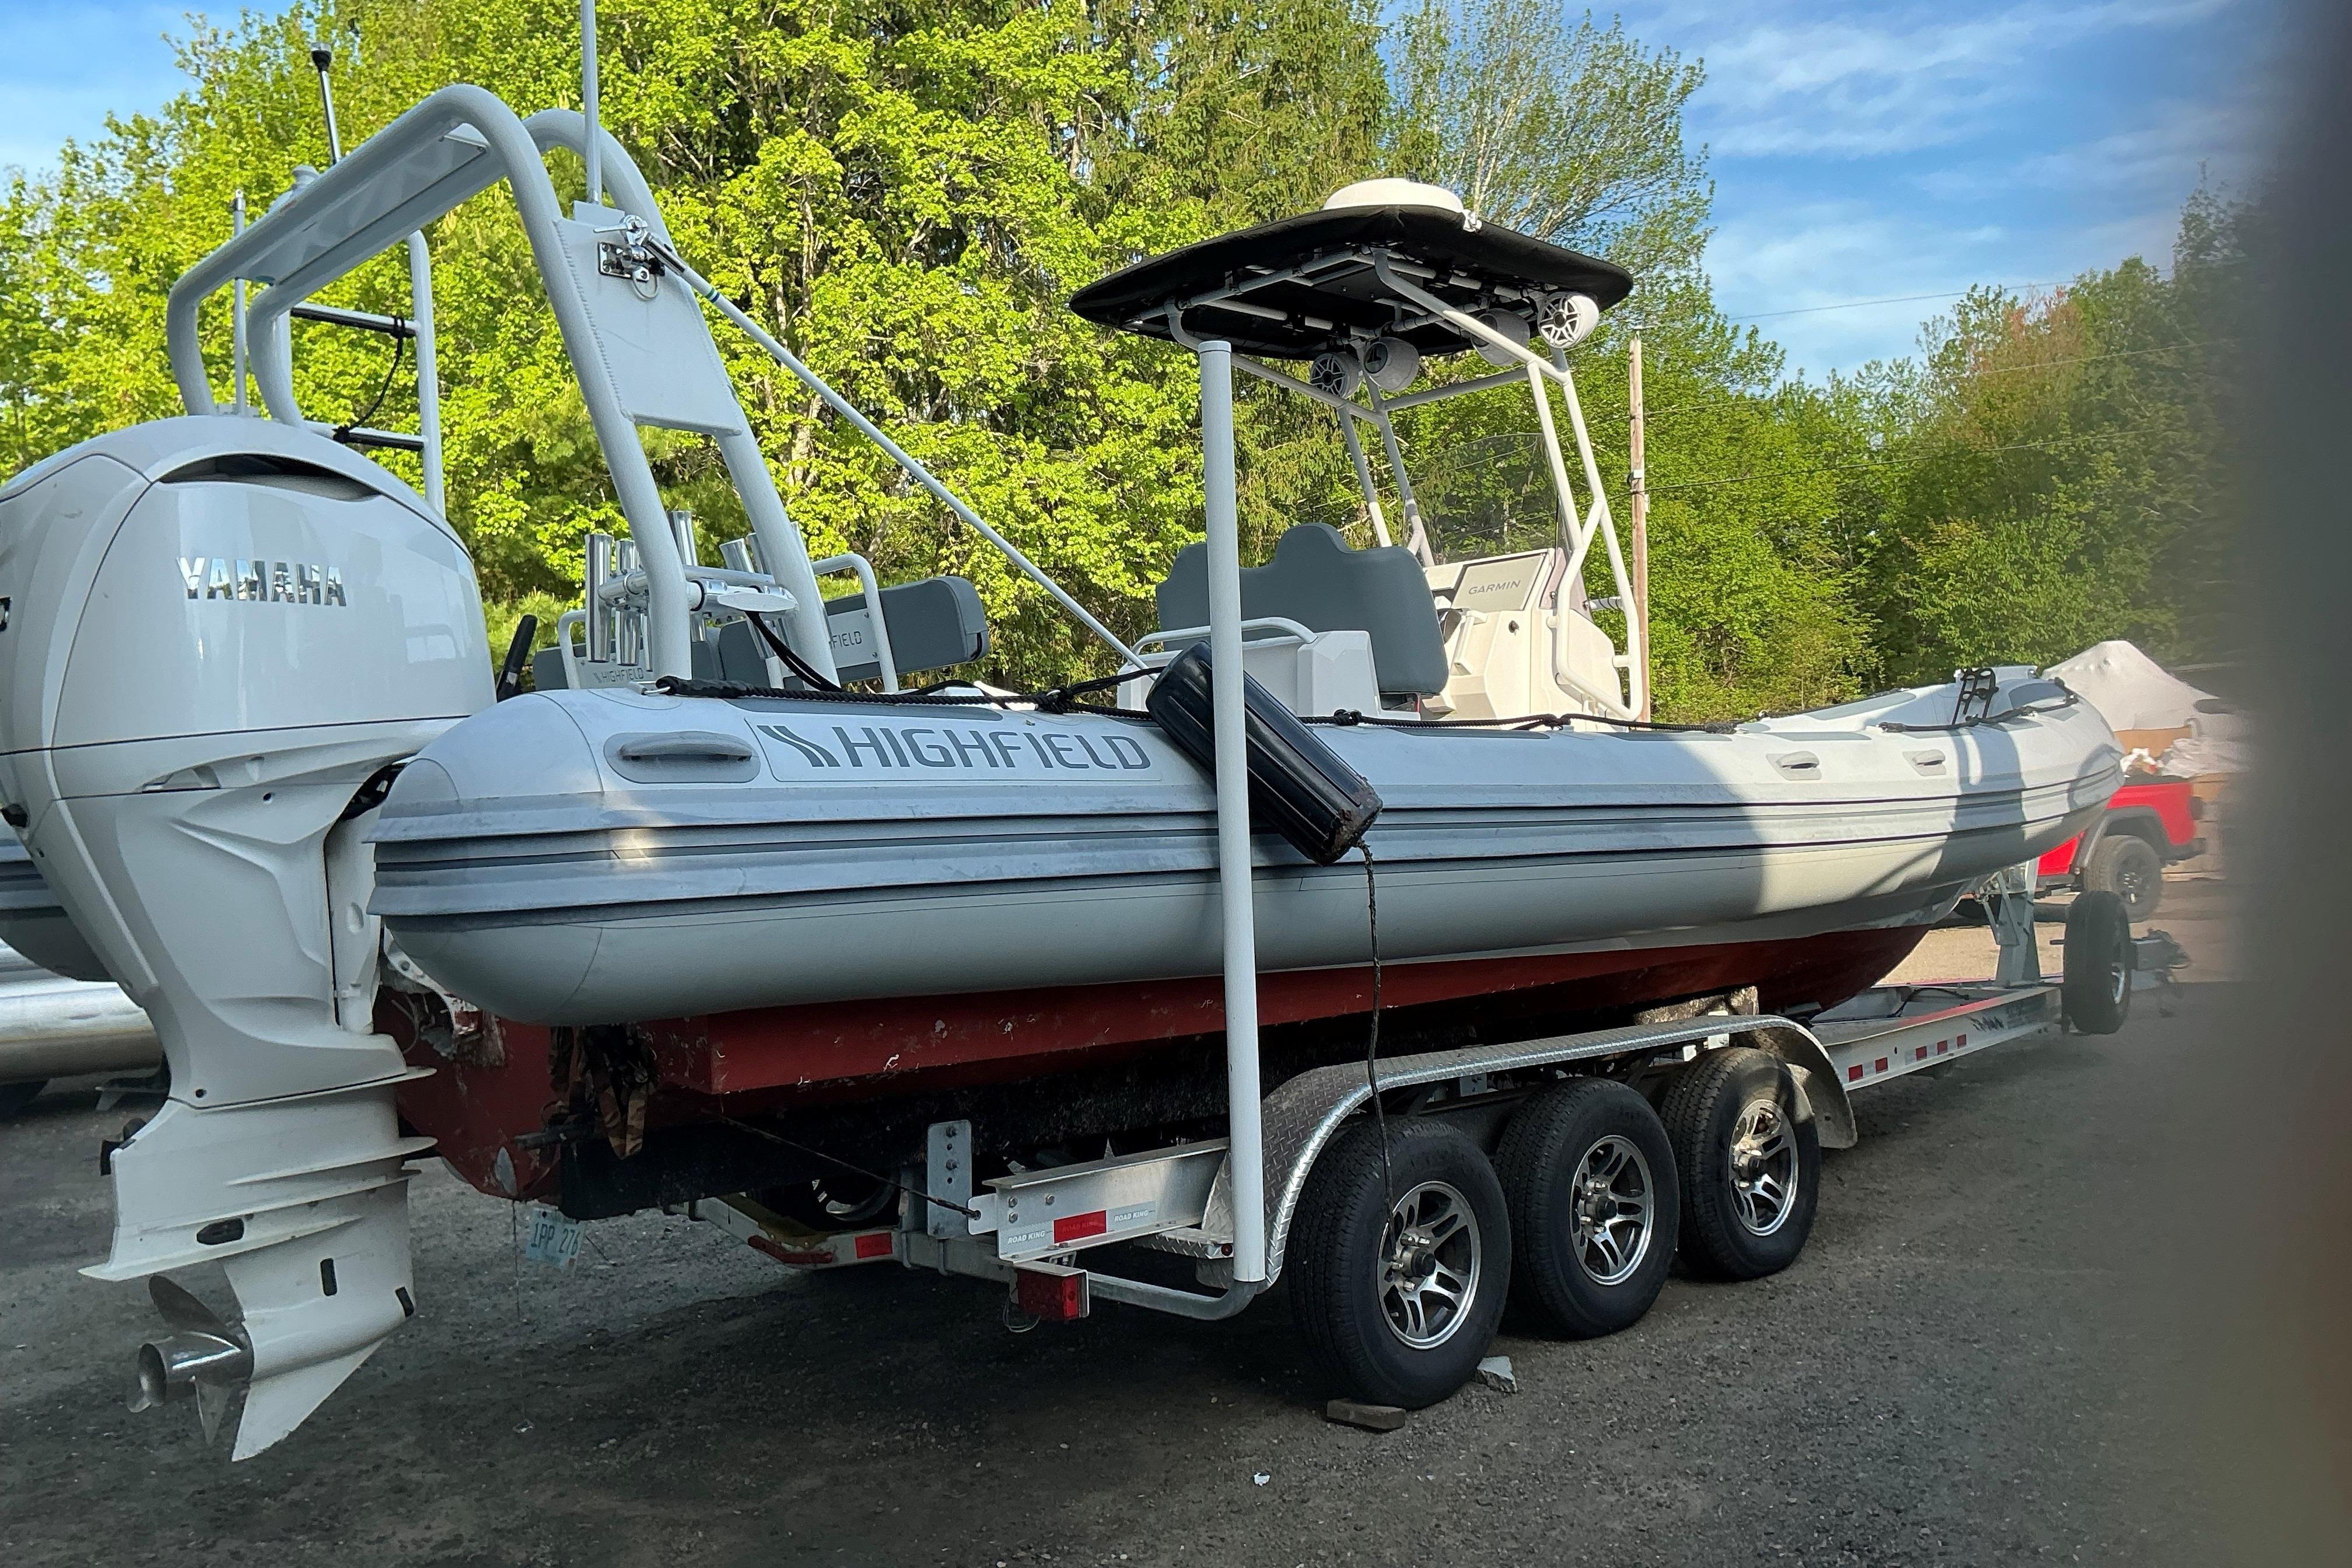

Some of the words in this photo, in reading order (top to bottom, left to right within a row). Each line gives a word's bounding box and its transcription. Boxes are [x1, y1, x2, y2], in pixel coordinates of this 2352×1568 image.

[176, 557, 346, 606] YAMAHA
[1468, 580, 1521, 595] GARMIN
[601, 667, 644, 683] HIGHFIELD
[832, 726, 1151, 770] HIGHFIELD
[1114, 1213, 1132, 1223] ROAD
[1132, 1209, 1149, 1219] KING
[531, 1222, 555, 1250] 1PP
[558, 1227, 581, 1256] 276
[1007, 1234, 1027, 1244] ROAD
[1028, 1230, 1045, 1240] KING
